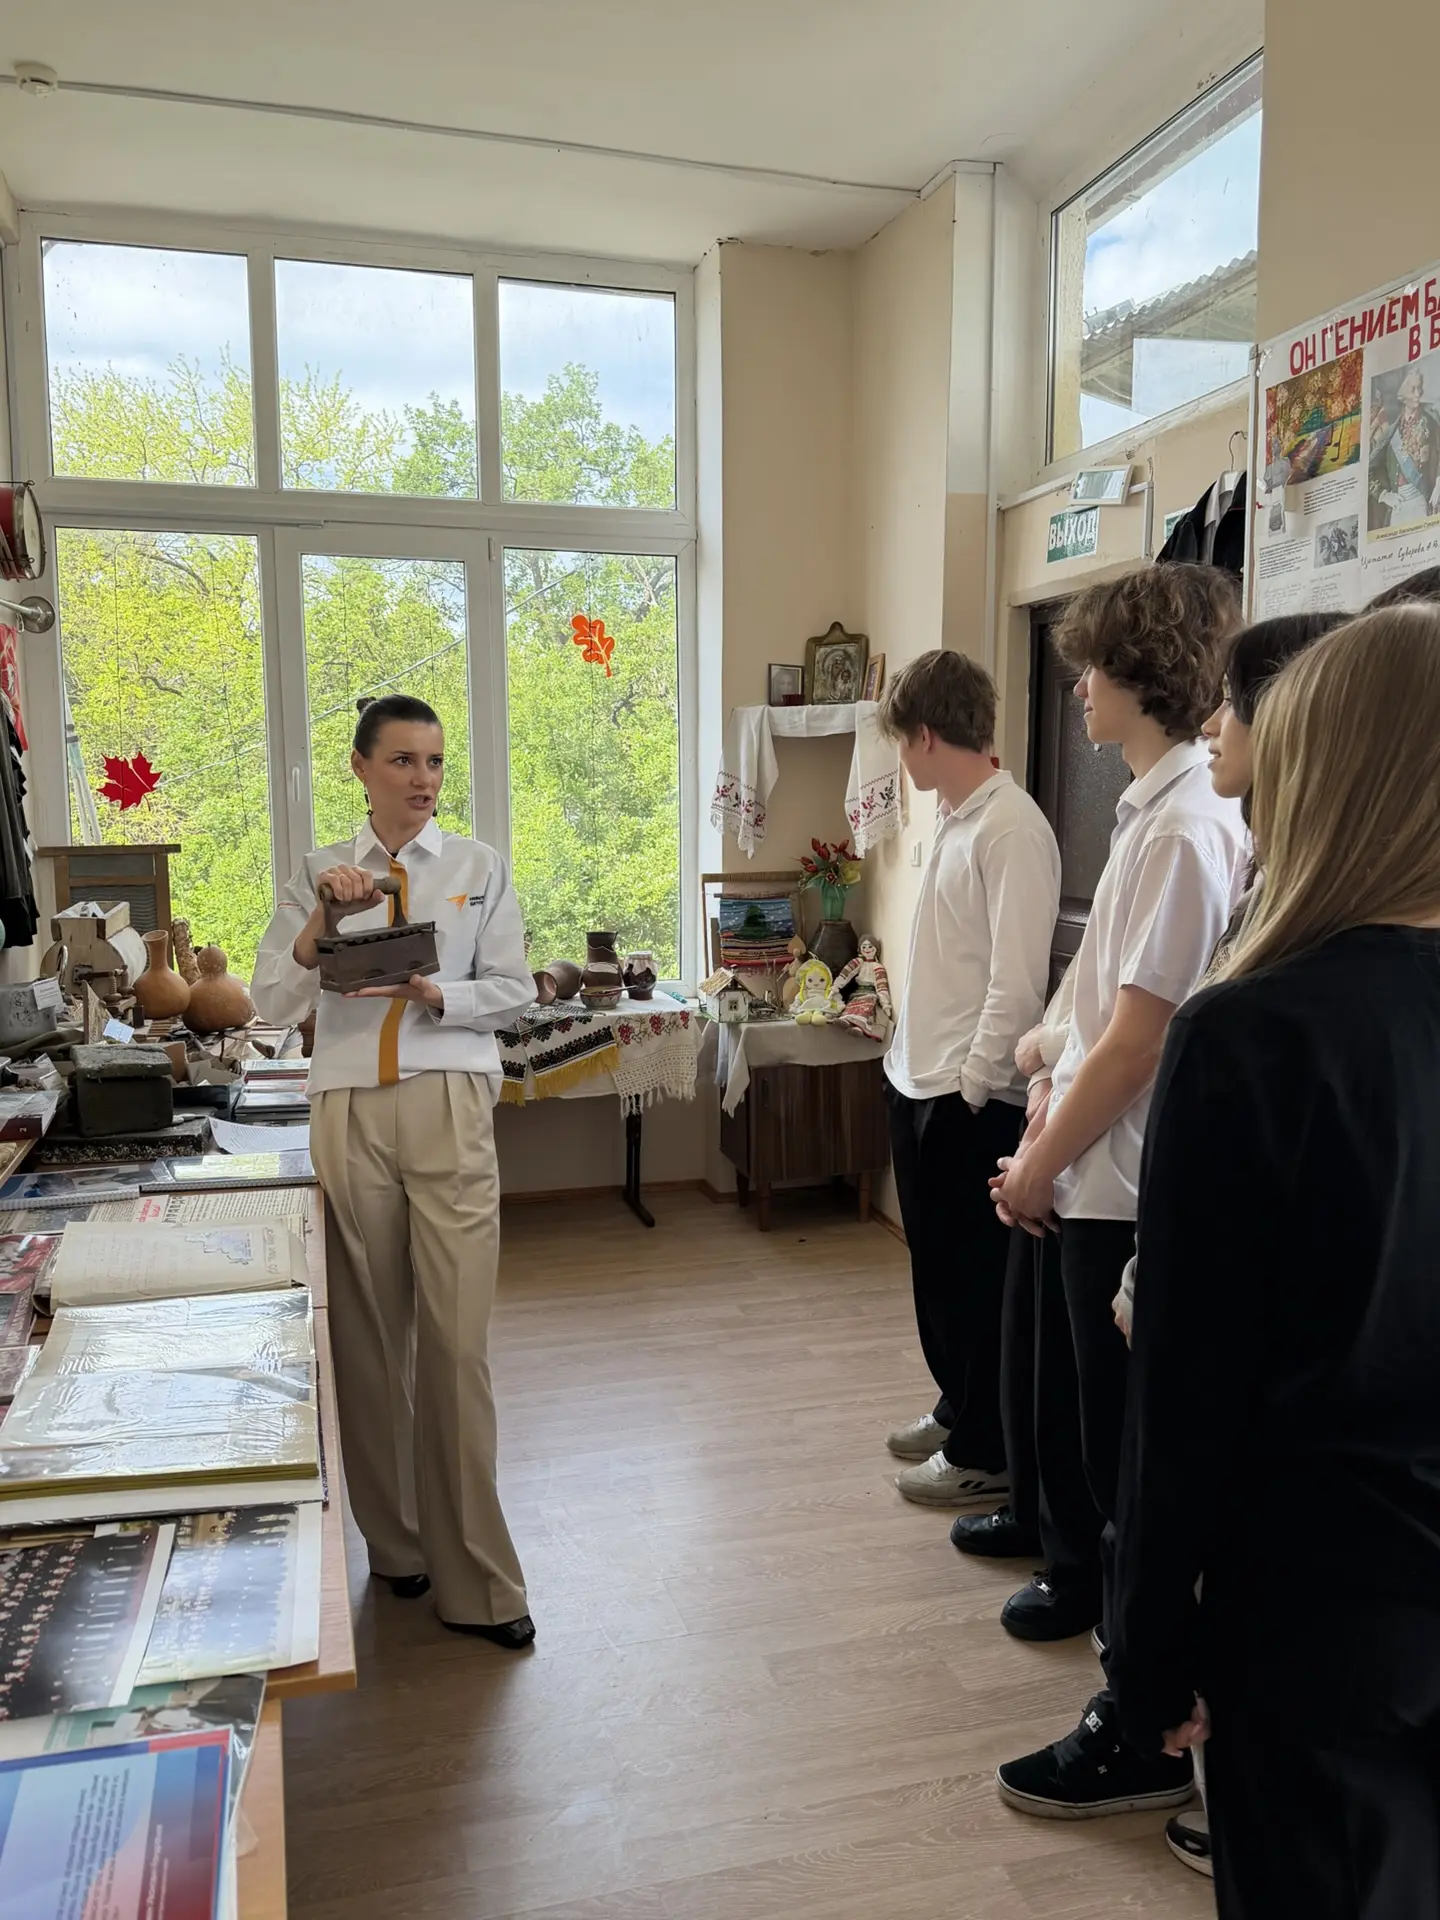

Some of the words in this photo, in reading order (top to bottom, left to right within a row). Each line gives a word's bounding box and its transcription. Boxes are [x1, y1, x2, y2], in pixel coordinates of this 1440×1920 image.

[1290, 333, 1316, 376] ОН
[1321, 288, 1420, 362] ГЕНИЕМ
[1424, 278, 1440, 317] Б
[1408, 323, 1422, 362] В
[1048, 514, 1097, 551] ВЫХОД
